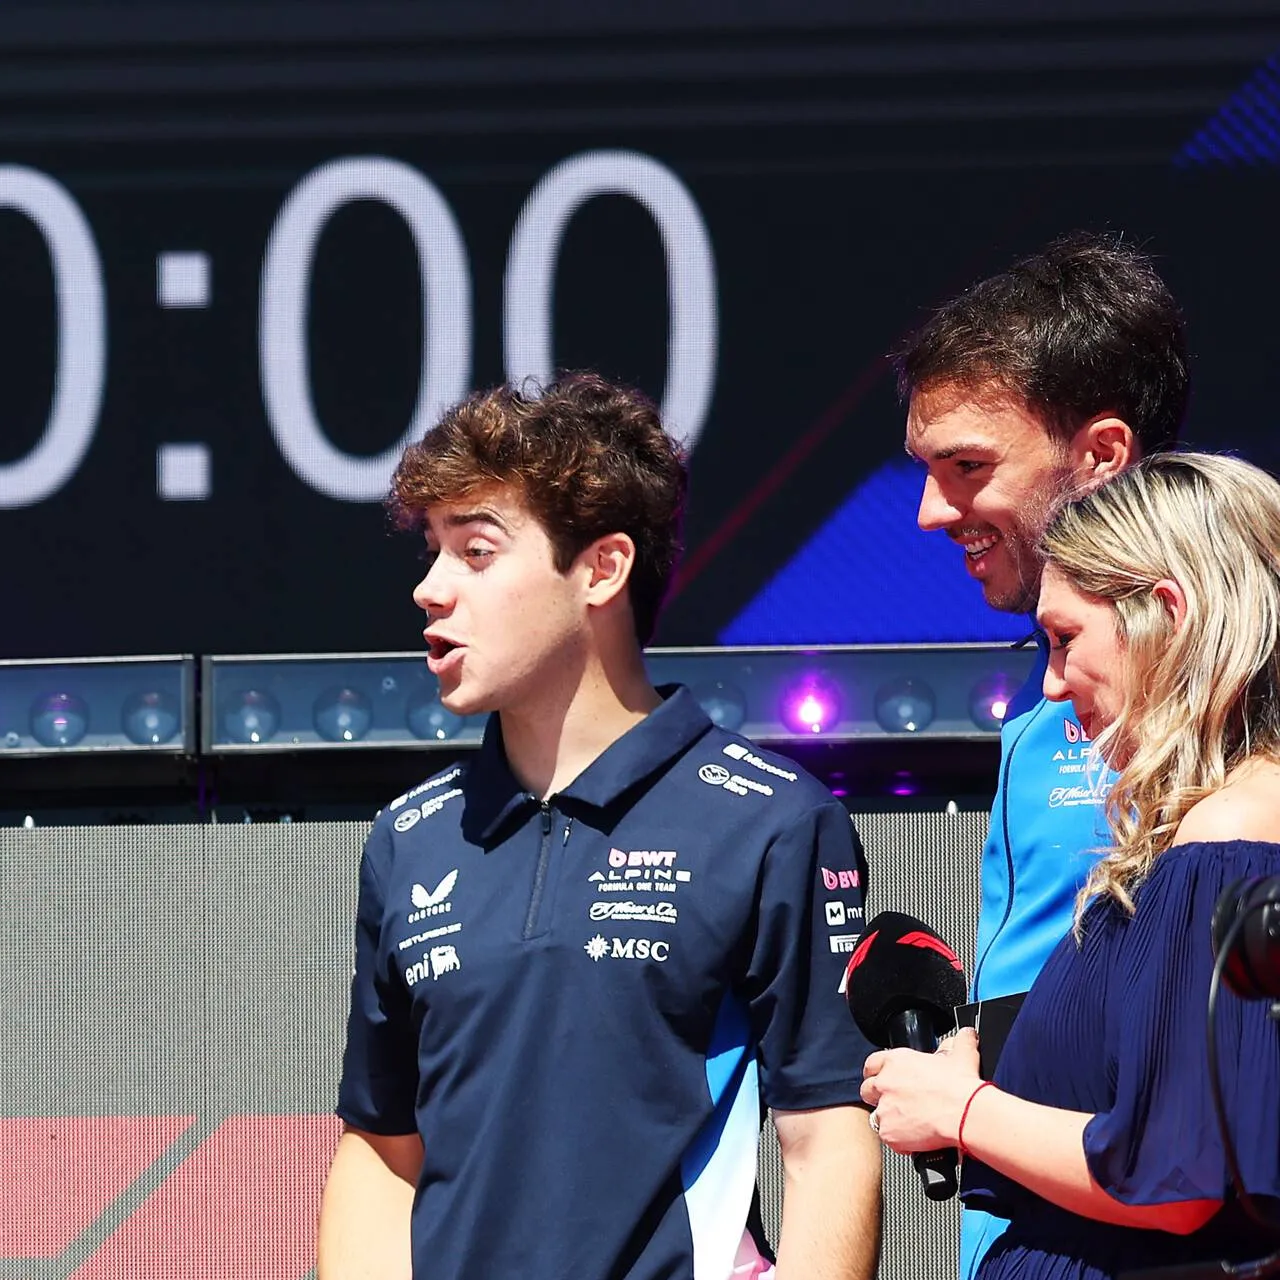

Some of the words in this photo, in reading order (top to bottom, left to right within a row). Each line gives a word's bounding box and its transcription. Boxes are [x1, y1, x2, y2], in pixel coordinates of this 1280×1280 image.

[627, 851, 677, 867] BWT
[587, 868, 692, 882] ALPINE
[610, 937, 670, 962] MSC
[405, 952, 429, 987] eni
